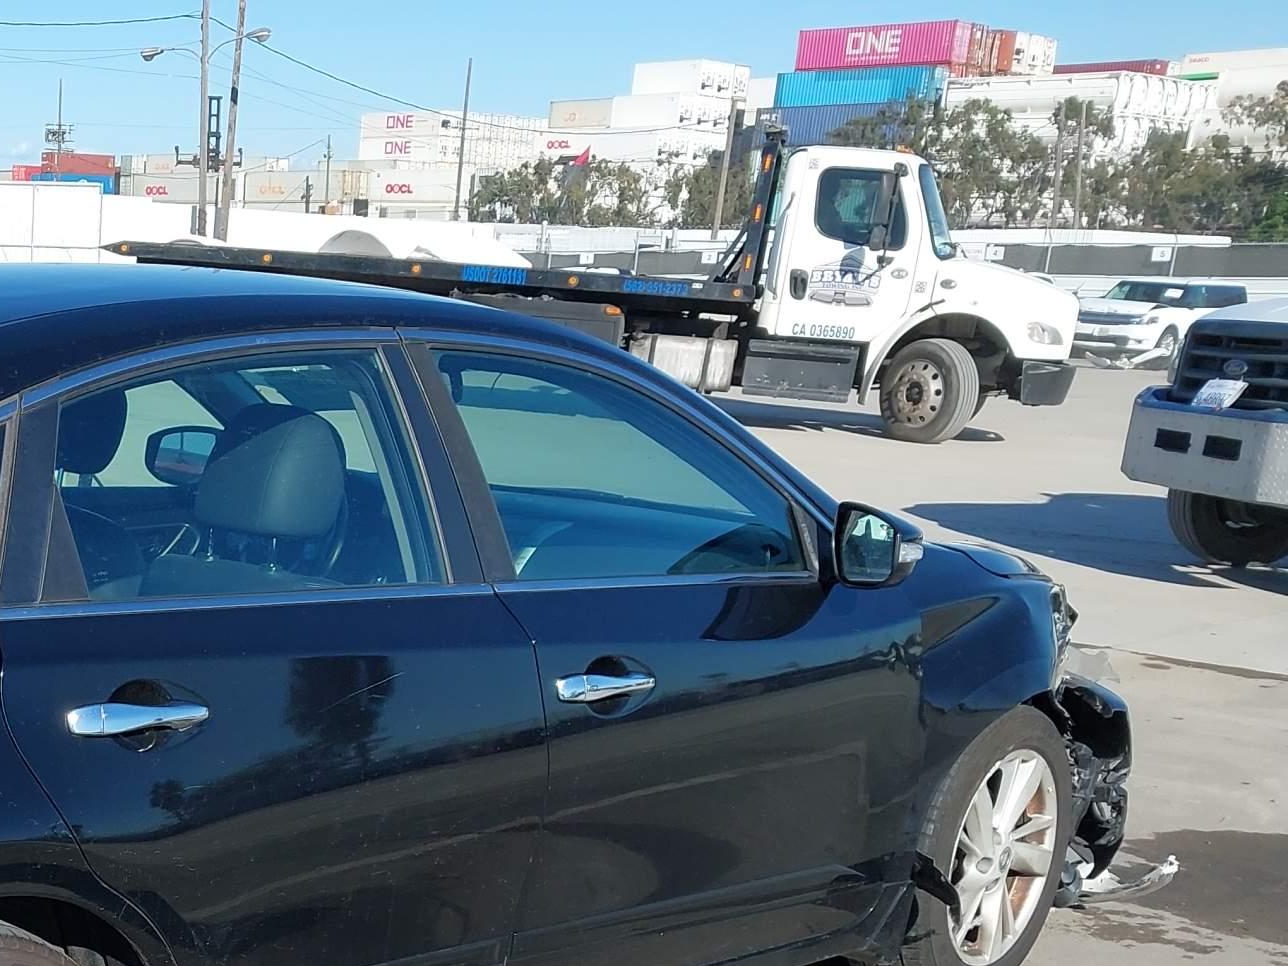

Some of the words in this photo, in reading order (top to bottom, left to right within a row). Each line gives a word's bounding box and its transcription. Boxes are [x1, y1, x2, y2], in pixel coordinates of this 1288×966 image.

[845, 29, 902, 56] ONE
[386, 115, 413, 130] ONE
[384, 141, 411, 155] ONE
[145, 186, 168, 196] OOCL
[385, 184, 413, 194] OOCL
[463, 265, 490, 282] USDOT
[792, 323, 806, 336] CA
[809, 324, 855, 339] 0365890
